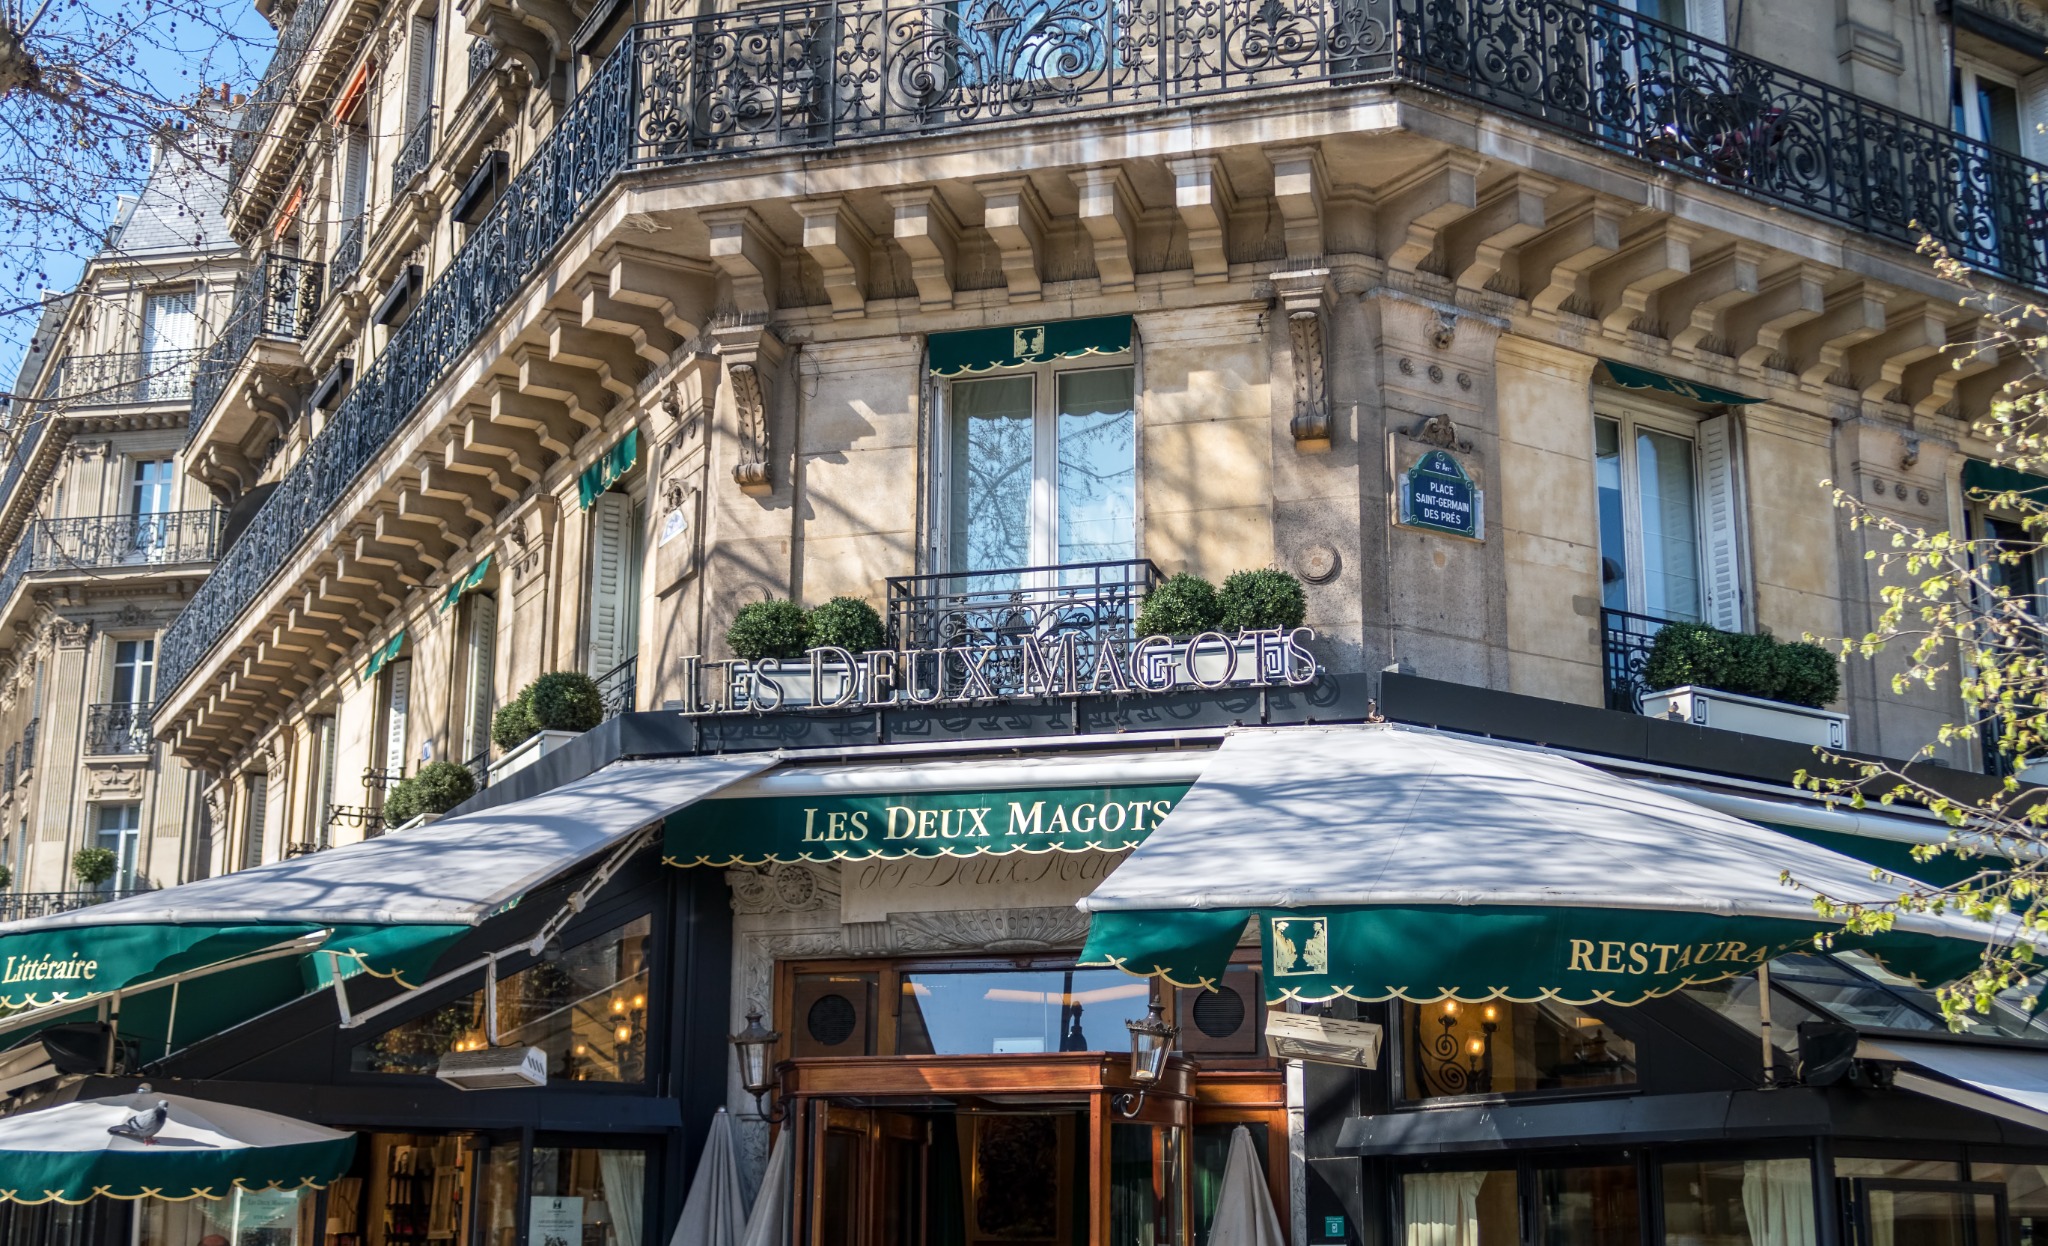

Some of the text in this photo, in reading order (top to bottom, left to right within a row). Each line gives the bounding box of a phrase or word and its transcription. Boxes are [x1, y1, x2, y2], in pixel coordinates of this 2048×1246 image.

[1415, 493, 1469, 512] SAINT-GERMAIN
[1430, 482, 1454, 496] PLACE
[1424, 508, 1461, 525] DES PRÉS
[678, 623, 1316, 716] LES DEUX MAGOTS
[801, 800, 1172, 842] LES DEUX MAGOTS
[1, 951, 98, 984] Littéraire
[1567, 938, 1770, 975] RESTAURA
